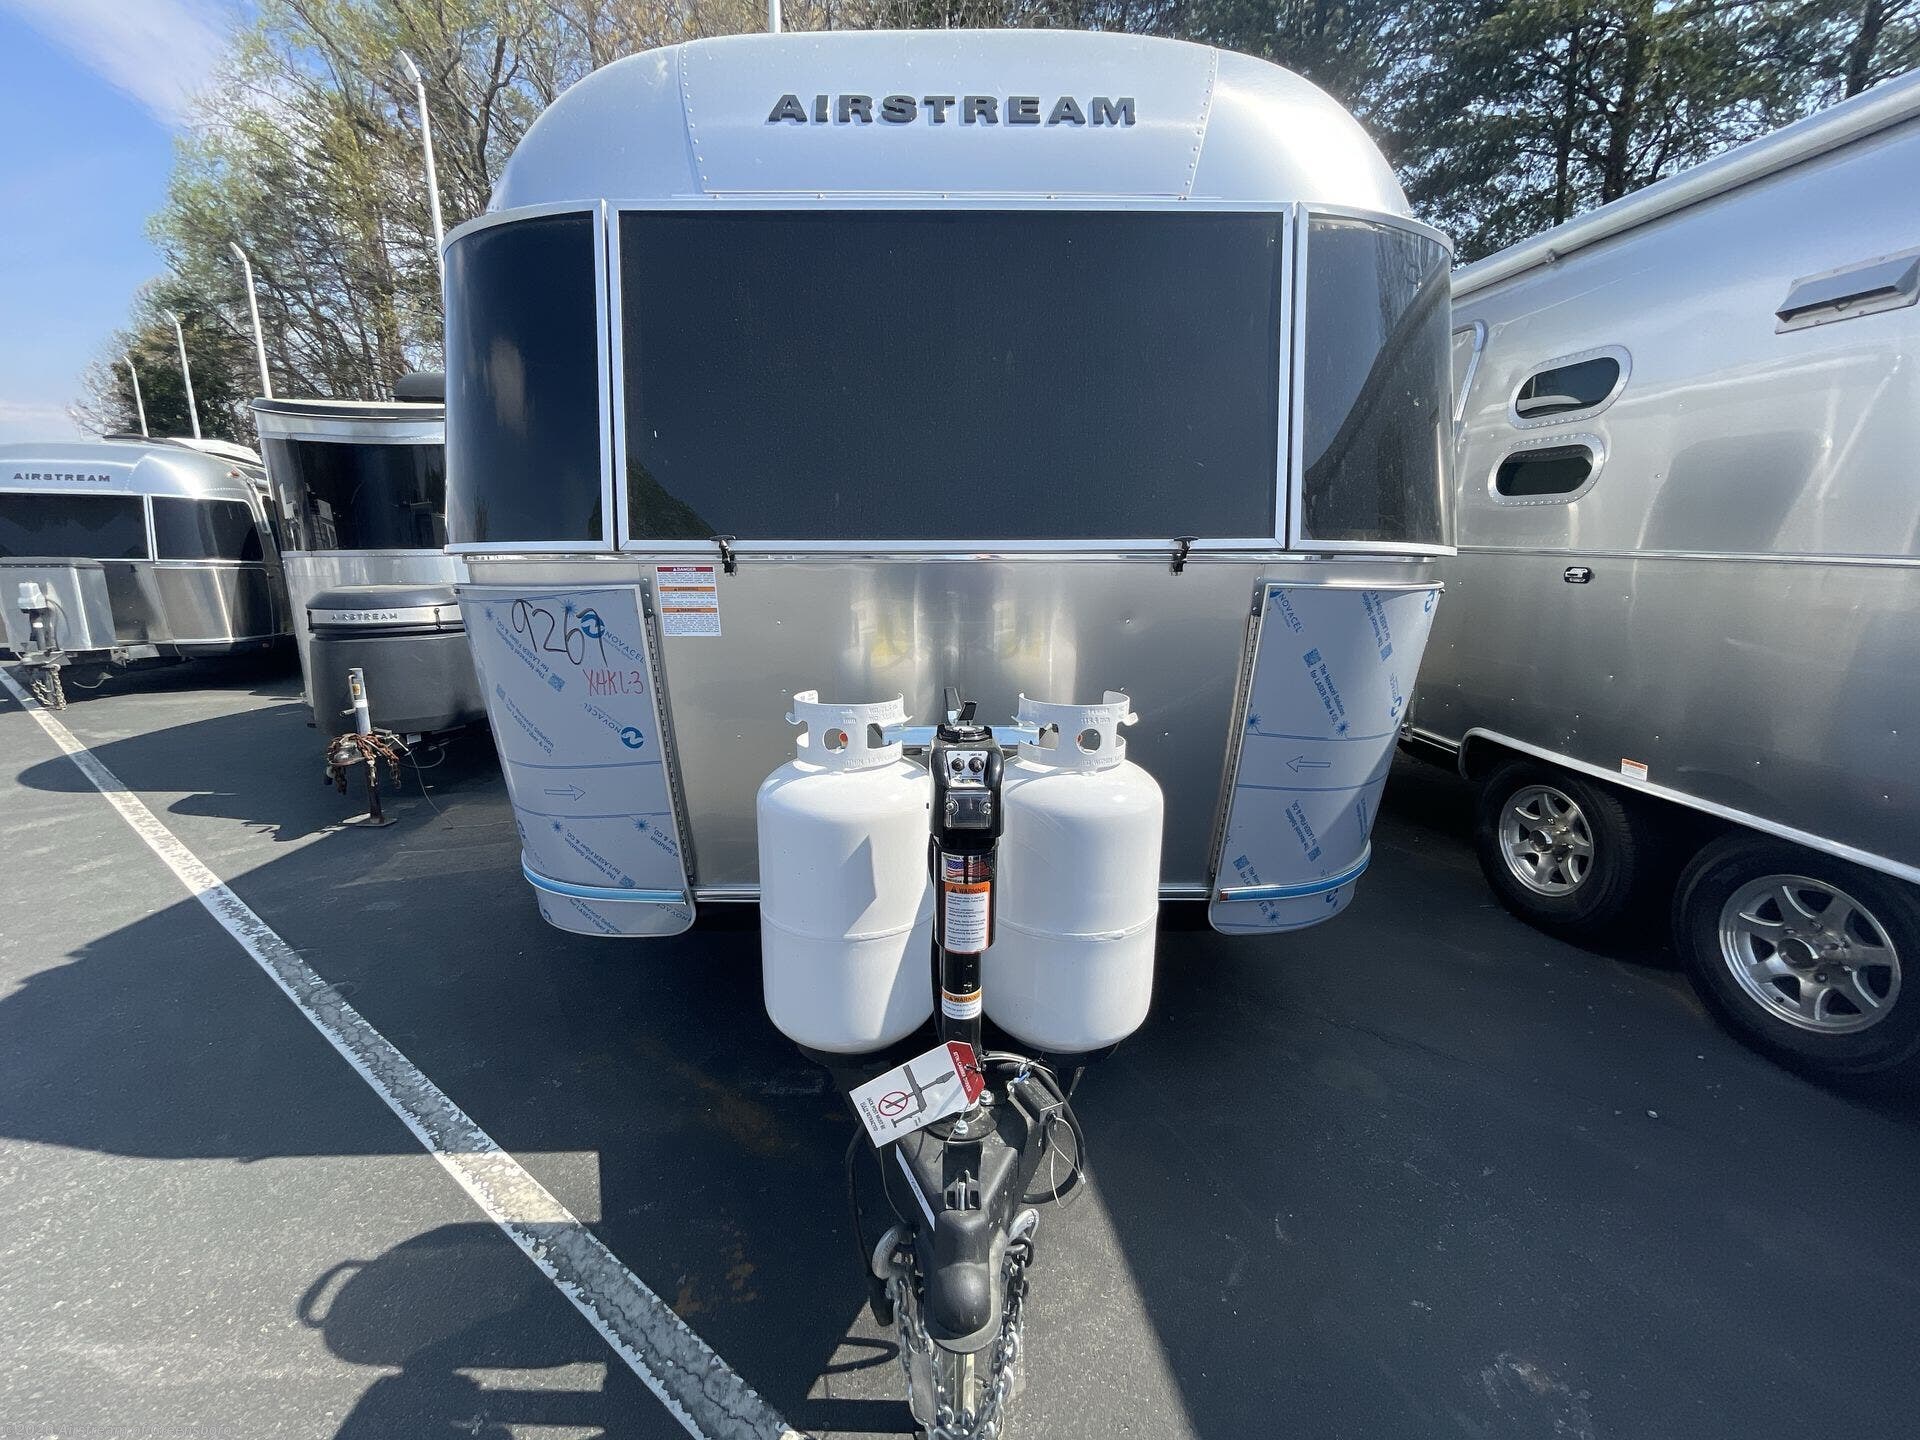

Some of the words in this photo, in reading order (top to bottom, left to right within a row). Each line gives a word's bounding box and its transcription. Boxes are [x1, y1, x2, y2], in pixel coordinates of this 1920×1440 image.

[768, 95, 1136, 125] AIRSTREAM
[13, 472, 110, 482] AIRSTREAM
[1279, 593, 1303, 633] NOVACEL
[512, 599, 607, 667] 9269
[604, 630, 645, 664] NOVACEL
[1318, 664, 1329, 675] The
[1309, 669, 1319, 679] for
[1314, 678, 1327, 696] LASER
[581, 702, 622, 734] NOVACEL
[564, 837, 586, 856] Solution
[580, 843, 594, 855] Fiber
[585, 855, 607, 872] Novacel
[593, 852, 612, 868] LASER
[606, 871, 616, 880] The
[612, 867, 622, 876] for
